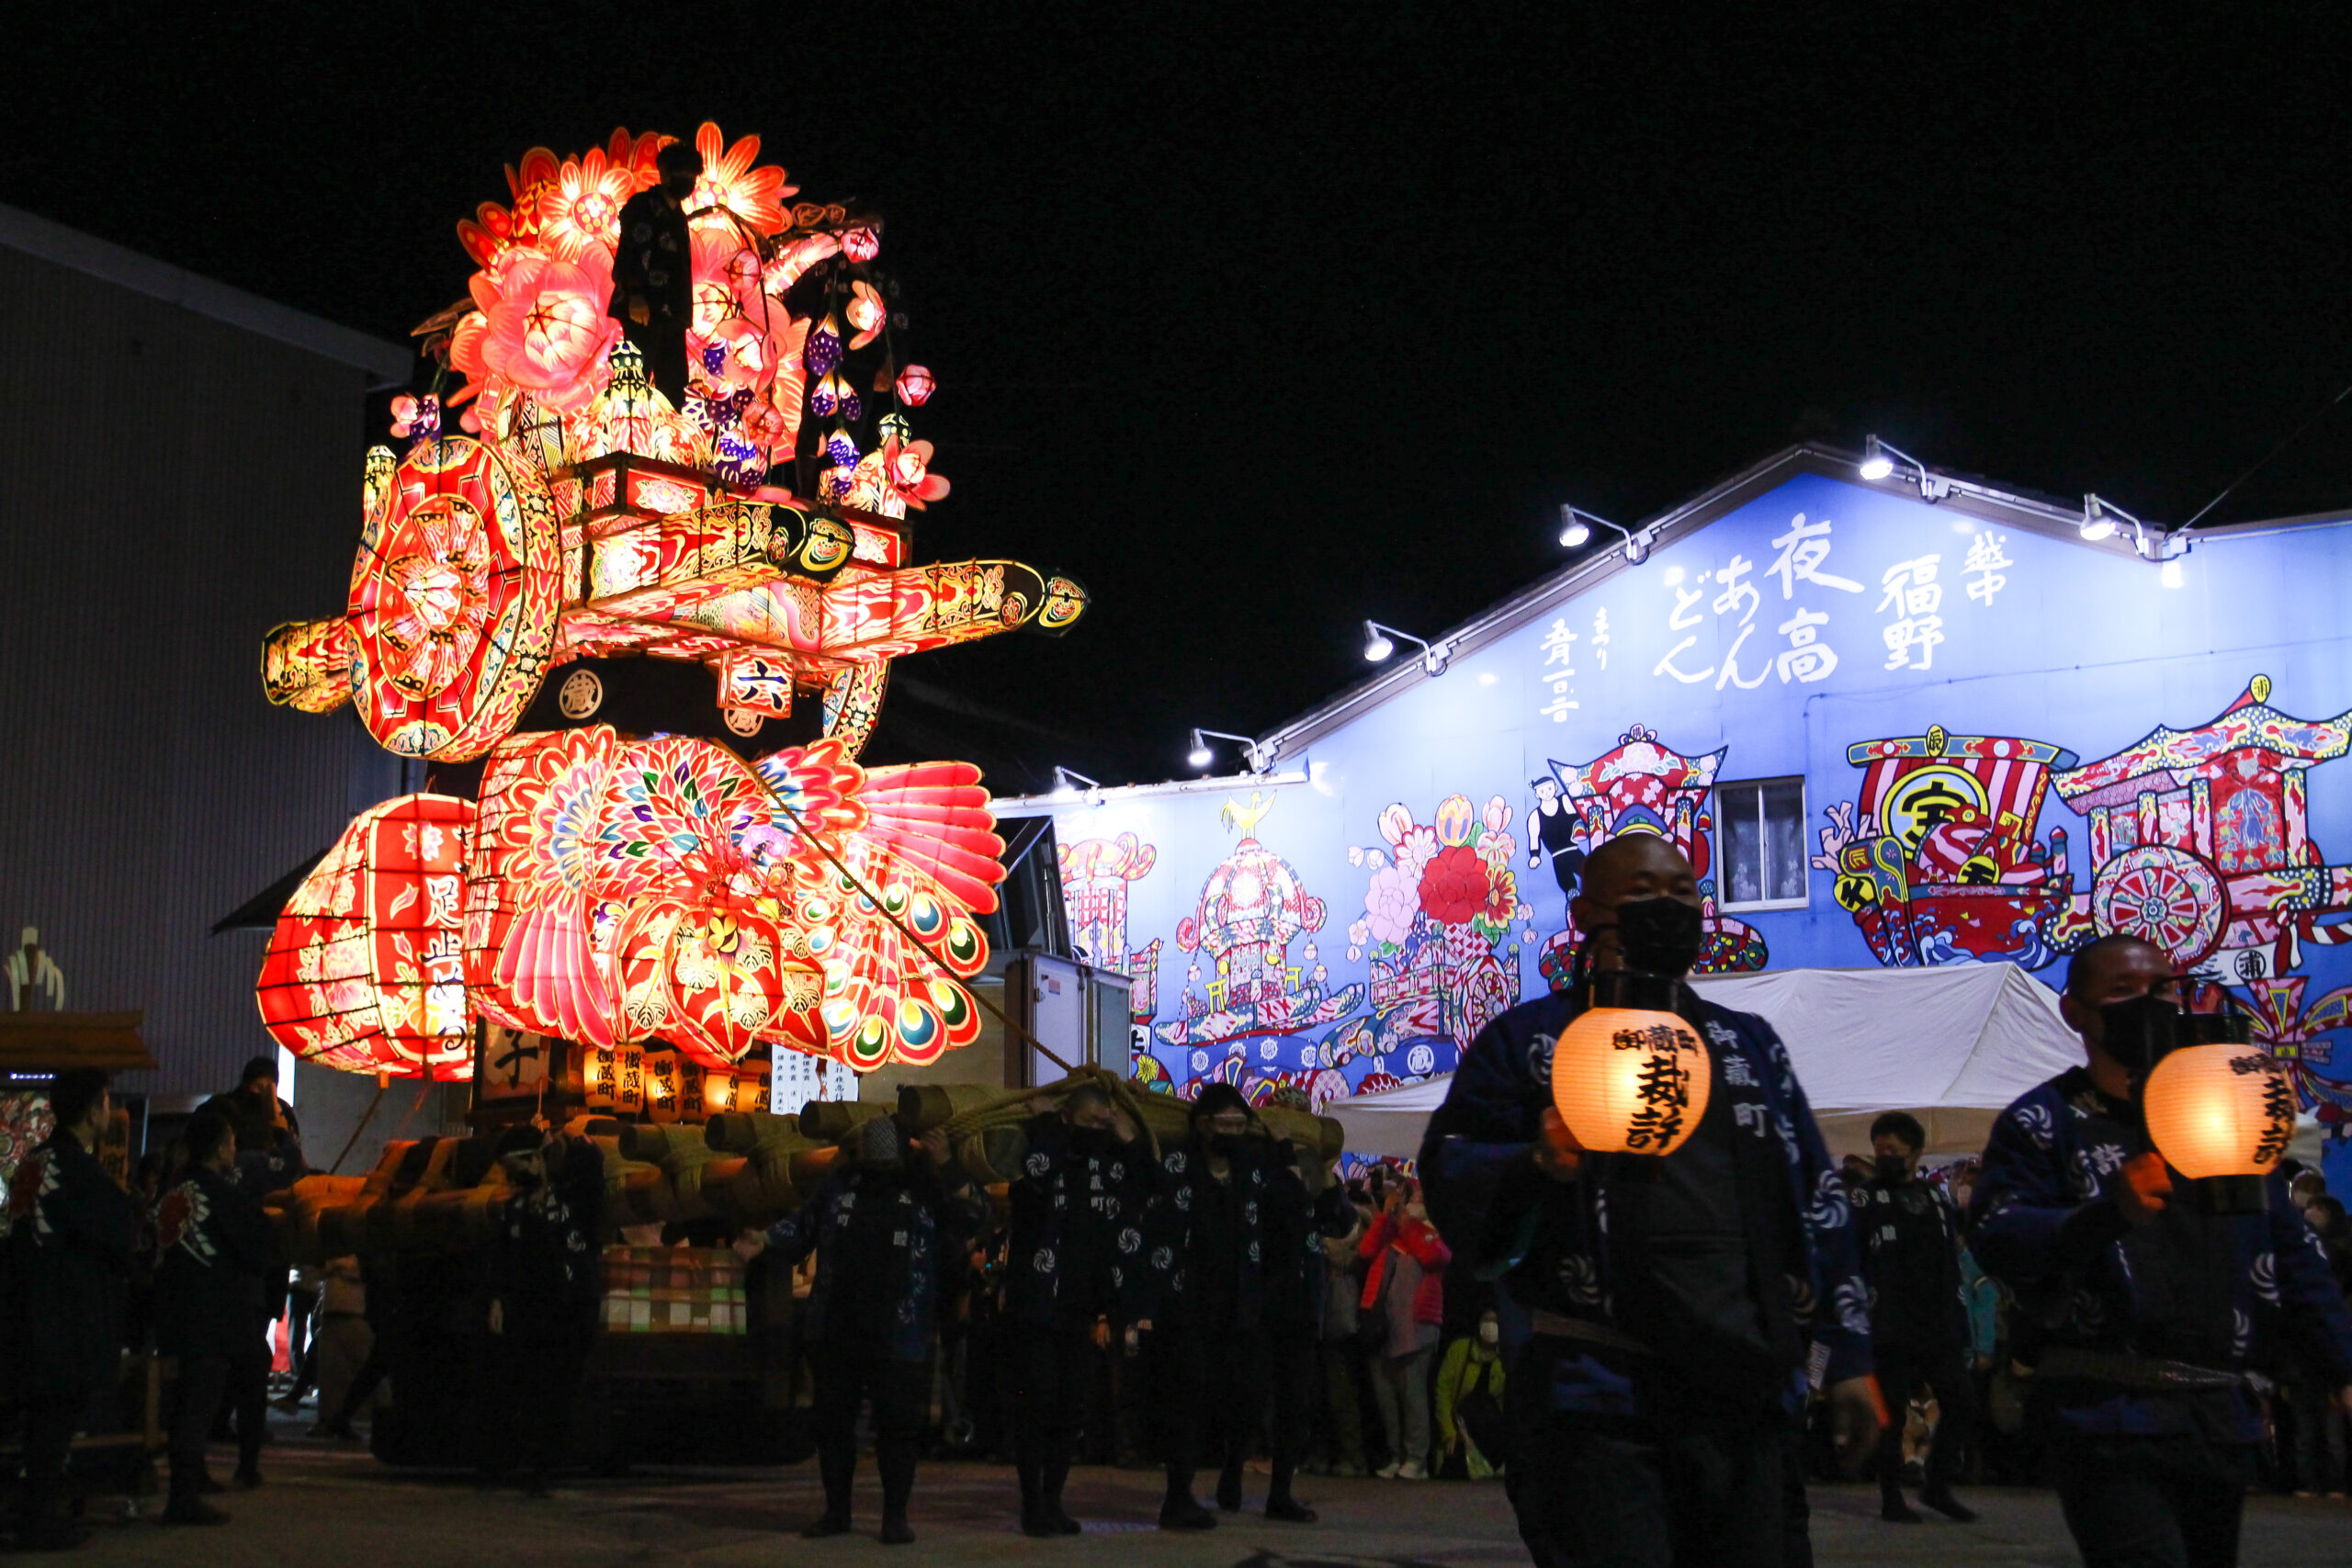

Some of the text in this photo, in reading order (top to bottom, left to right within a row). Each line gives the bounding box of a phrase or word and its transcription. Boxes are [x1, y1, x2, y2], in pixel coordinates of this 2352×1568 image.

[1765, 513, 1865, 684] 夜高
[1875, 554, 1946, 671] 福野
[1961, 530, 2014, 607] 越中
[738, 660, 787, 710] 六
[1625, 1054, 1690, 1149] 裁許
